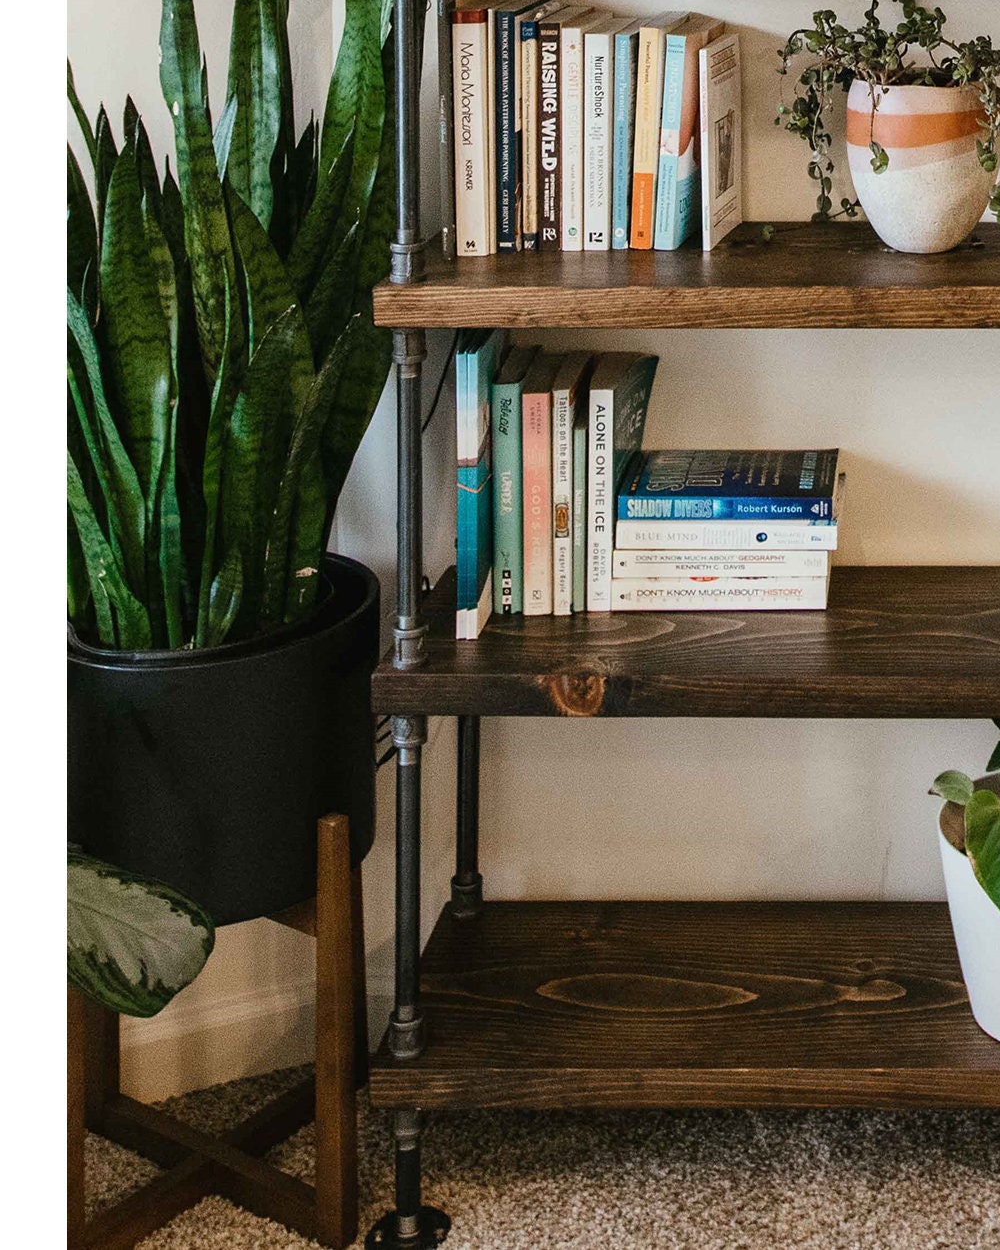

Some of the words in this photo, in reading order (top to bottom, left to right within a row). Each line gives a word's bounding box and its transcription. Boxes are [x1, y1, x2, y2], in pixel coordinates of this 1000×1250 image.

[460, 42, 474, 80] Maria
[594, 56, 604, 118] NurtureShock
[617, 82, 627, 121] Parenting
[462, 83, 474, 146] Montessori
[542, 118, 557, 172] WILD
[560, 396, 568, 428] Tattoos
[560, 431, 566, 442] on
[596, 404, 606, 450] ALONE
[560, 444, 568, 456] the
[560, 460, 568, 482] Heart
[596, 456, 606, 475] ON
[595, 480, 605, 506] THE
[626, 500, 673, 518] SHADOW
[674, 500, 714, 518] DIVERS
[738, 504, 768, 513] Robert
[771, 504, 802, 514] Kurson
[594, 512, 604, 532] ICE
[635, 532, 662, 540] BLUE
[666, 532, 698, 540] MIND
